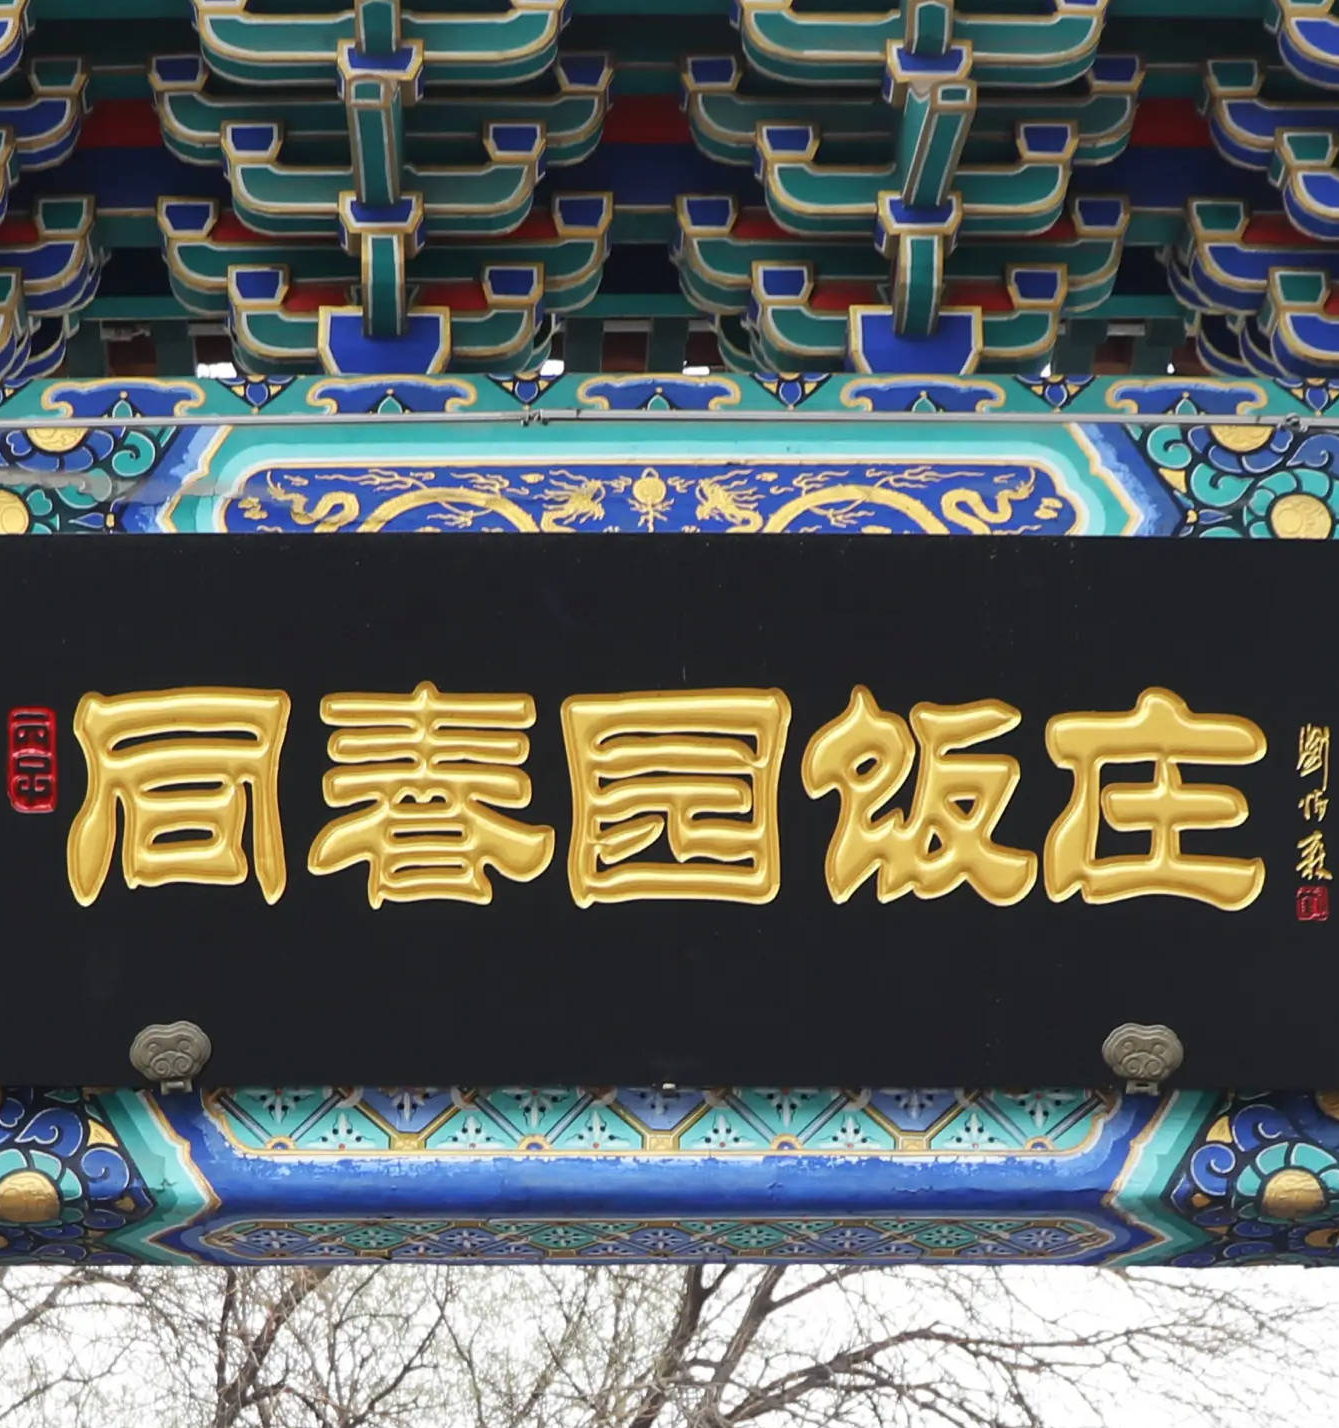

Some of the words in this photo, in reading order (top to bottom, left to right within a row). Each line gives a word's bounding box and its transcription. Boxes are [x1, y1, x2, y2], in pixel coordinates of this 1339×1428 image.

[66, 680, 1268, 911] 同春园饭庄
